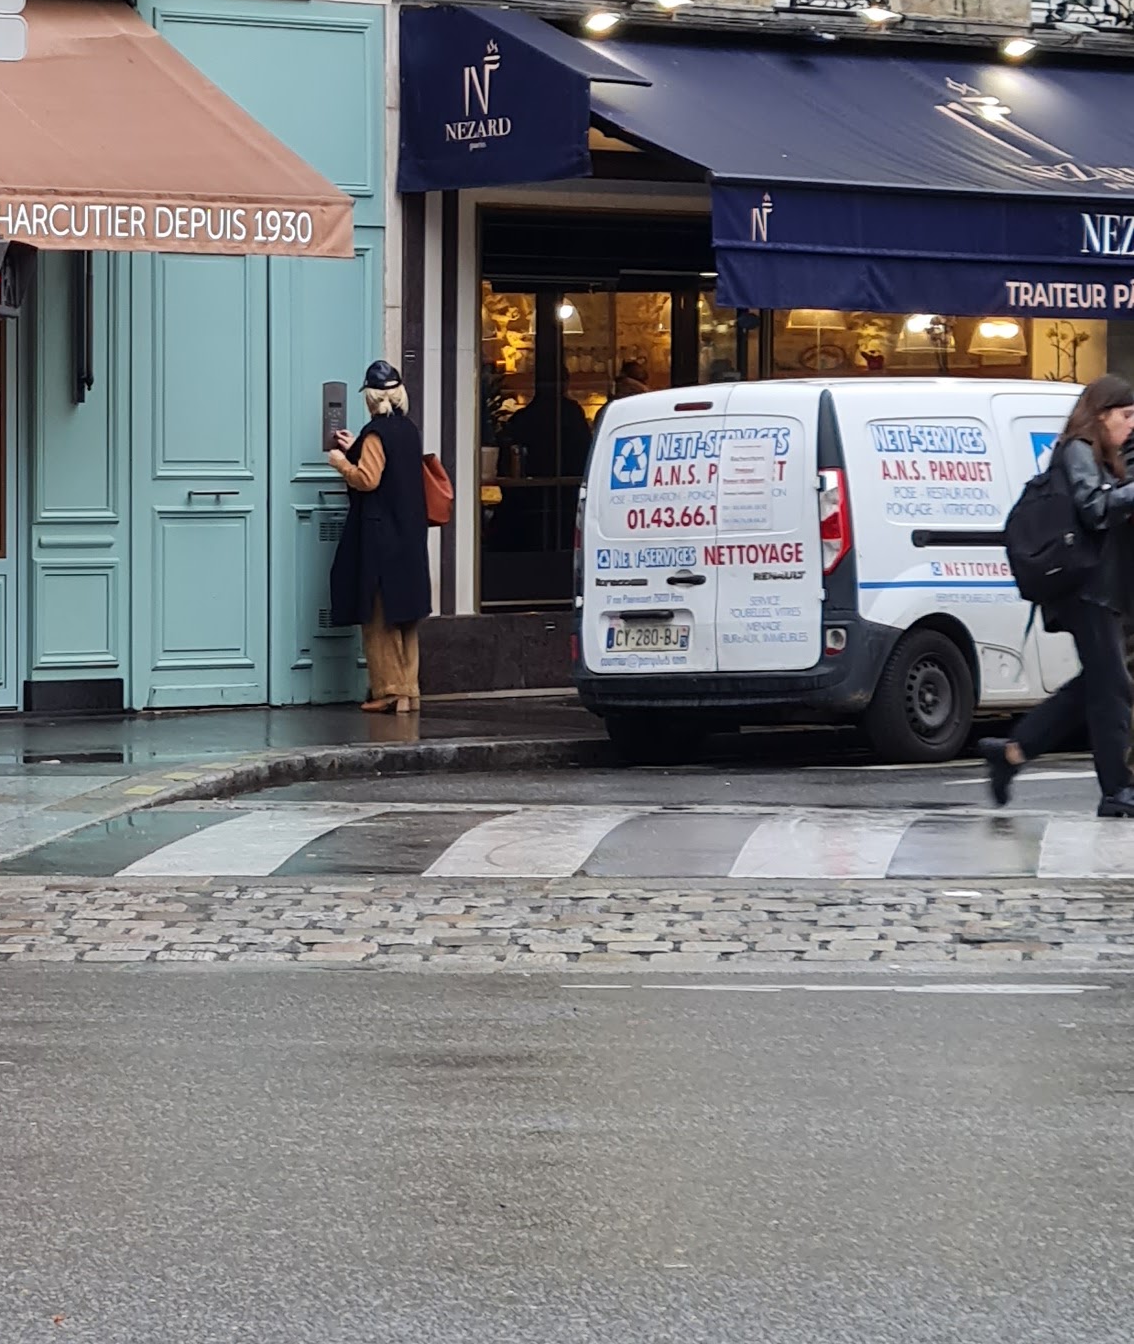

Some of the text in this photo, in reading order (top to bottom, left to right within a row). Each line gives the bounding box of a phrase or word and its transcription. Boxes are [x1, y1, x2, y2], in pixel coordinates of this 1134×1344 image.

[445, 117, 512, 142] NEZARD
[155, 207, 247, 242] DEPUIS
[253, 210, 313, 244] 1930
[1006, 281, 1107, 308] TRAITEUR
[870, 424, 987, 454] NETT-SERVICES
[653, 463, 701, 487] A.N.S.
[882, 460, 993, 482] A.N.S. PARQUET
[626, 505, 717, 530] 01.43.66.1
[703, 543, 804, 566] NETTOYAGE
[752, 570, 806, 581] RENAULT
[943, 562, 1010, 576] NETTOYAG
[615, 627, 679, 648] CY-280-BJ
